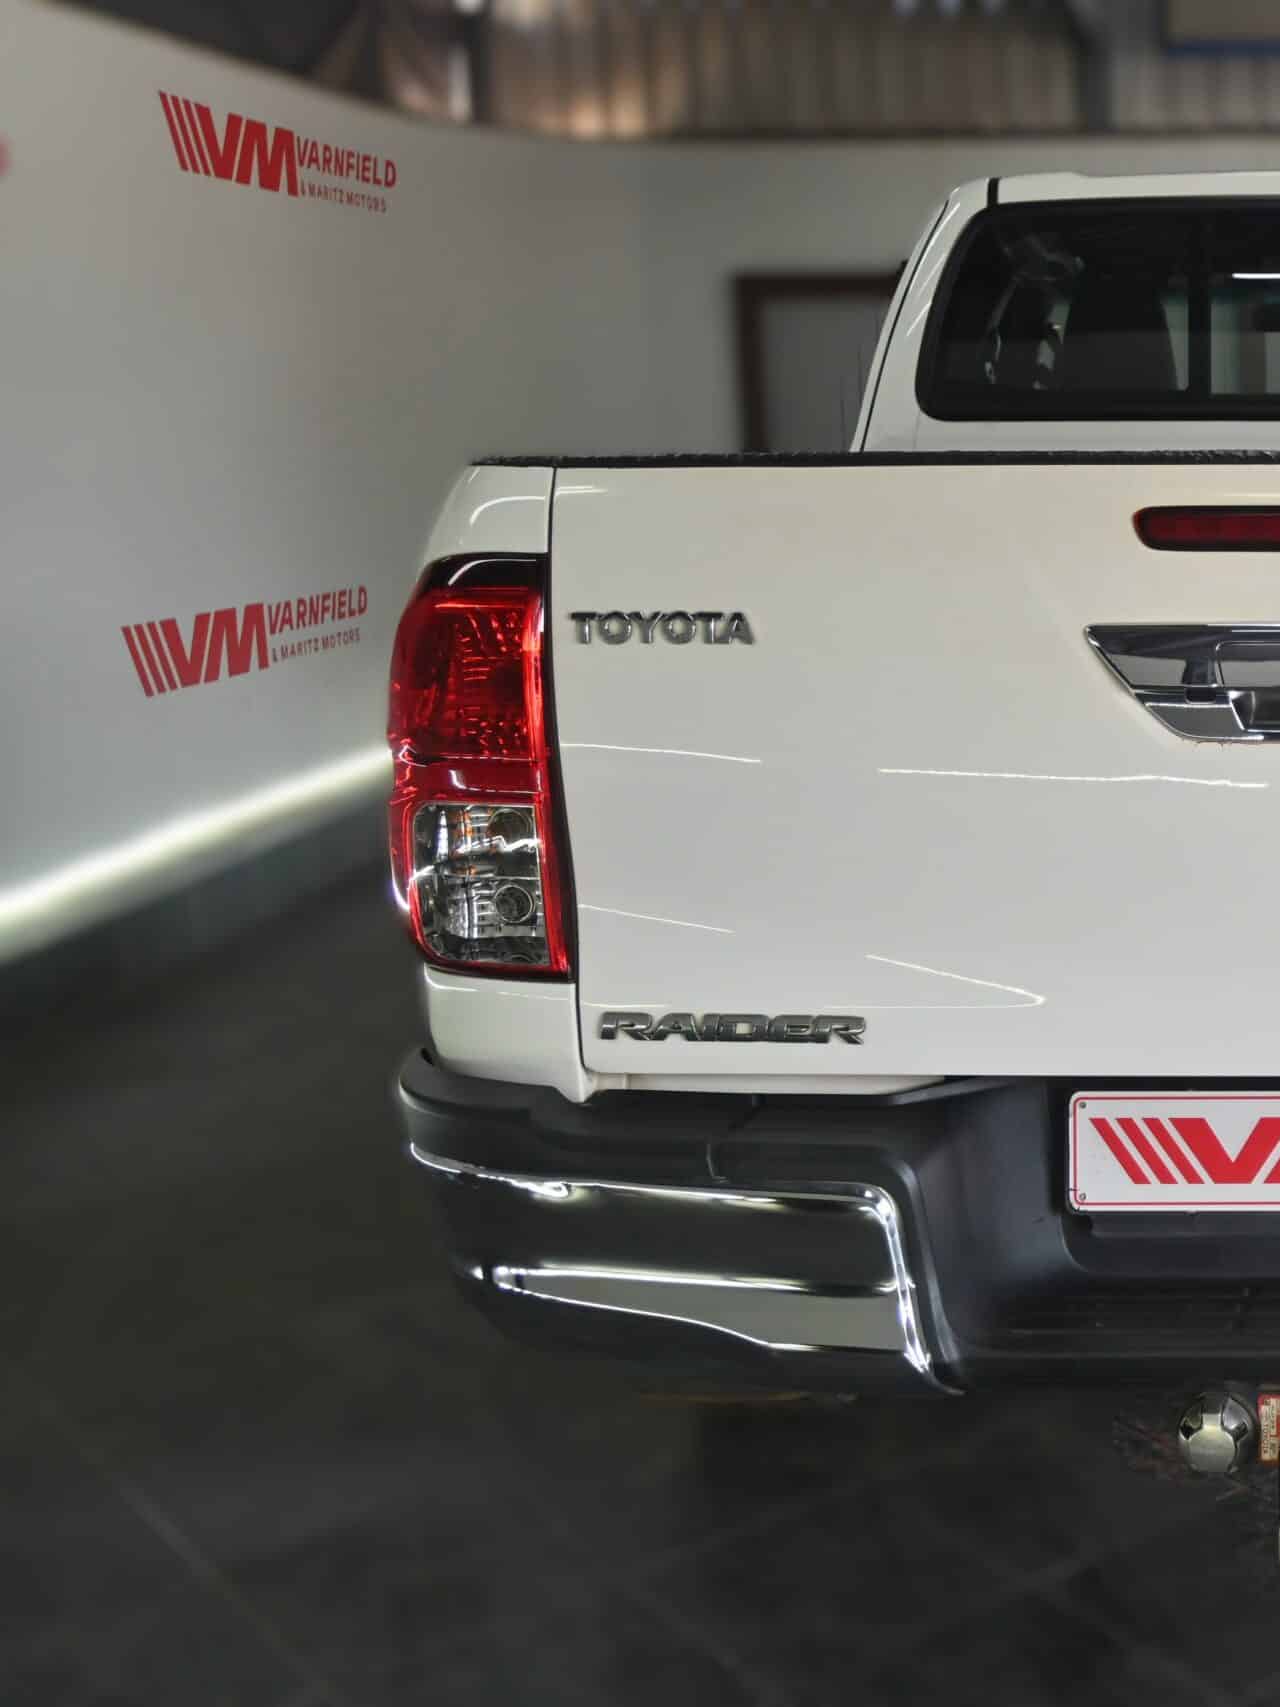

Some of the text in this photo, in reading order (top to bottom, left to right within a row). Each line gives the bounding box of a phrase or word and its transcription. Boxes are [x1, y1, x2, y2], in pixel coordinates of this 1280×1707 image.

[297, 135, 397, 188] VARNFIELD
[267, 585, 367, 635] VARNFIELD
[569, 611, 755, 645] TOYOTA
[599, 1011, 866, 1045] RAIDER
